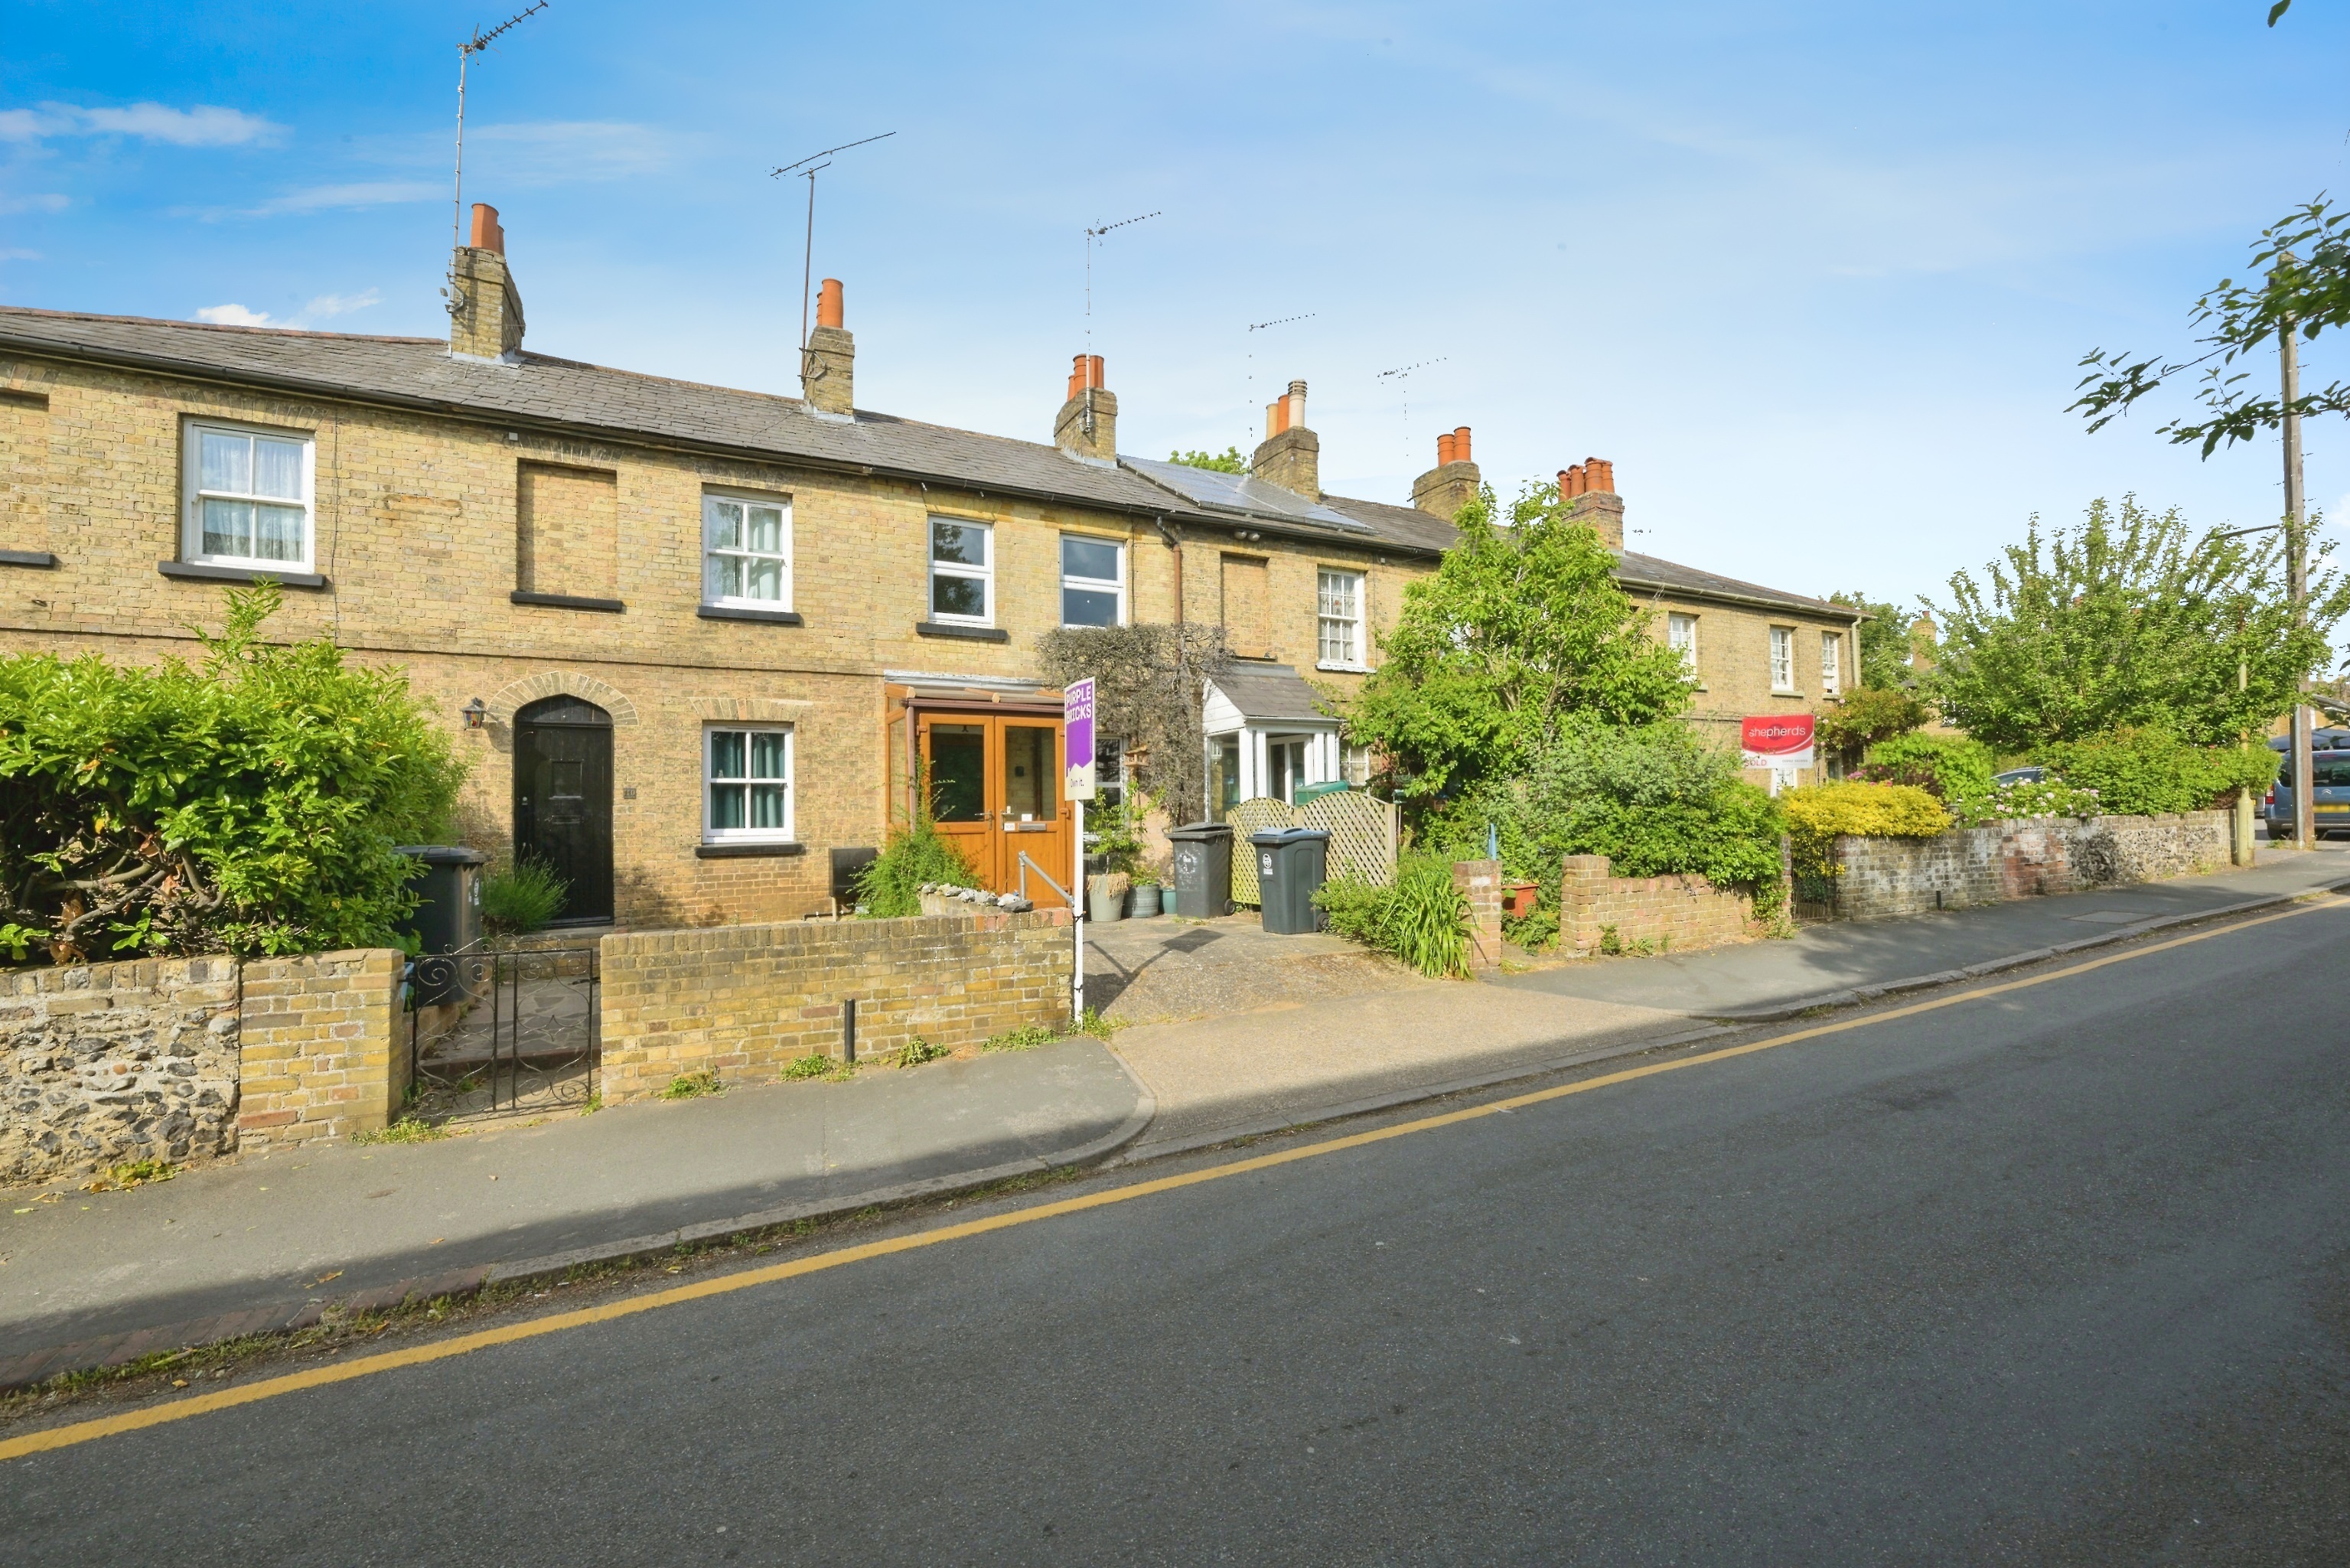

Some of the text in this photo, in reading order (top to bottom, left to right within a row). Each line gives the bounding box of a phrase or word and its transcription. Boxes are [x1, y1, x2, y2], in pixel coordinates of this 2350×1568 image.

[1066, 685, 1092, 709] PURPLE
[1066, 703, 1092, 725] BRICKS
[1749, 725, 1806, 739] shepherds
